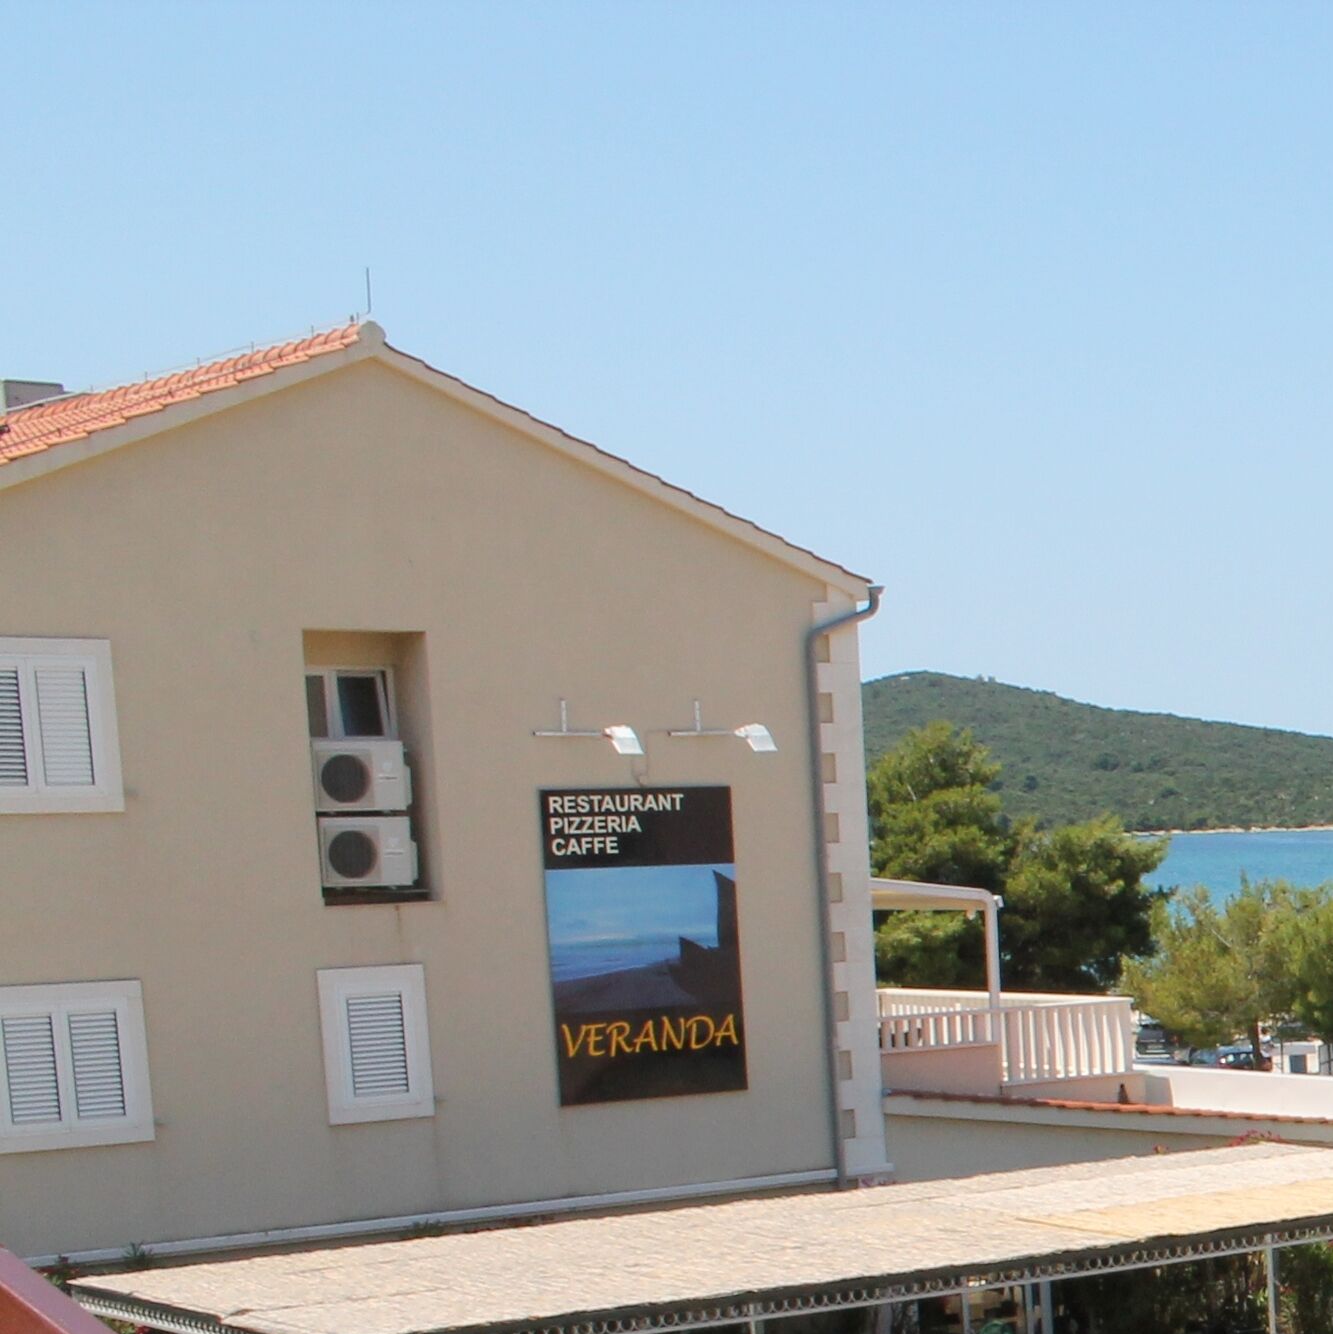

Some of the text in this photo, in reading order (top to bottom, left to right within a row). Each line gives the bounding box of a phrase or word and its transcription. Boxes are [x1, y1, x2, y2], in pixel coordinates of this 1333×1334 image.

[548, 793, 684, 814] RESTAURANT
[549, 815, 642, 835] PIZZERIA
[551, 836, 619, 856] CAFFE
[561, 1013, 739, 1058] VERANDA
